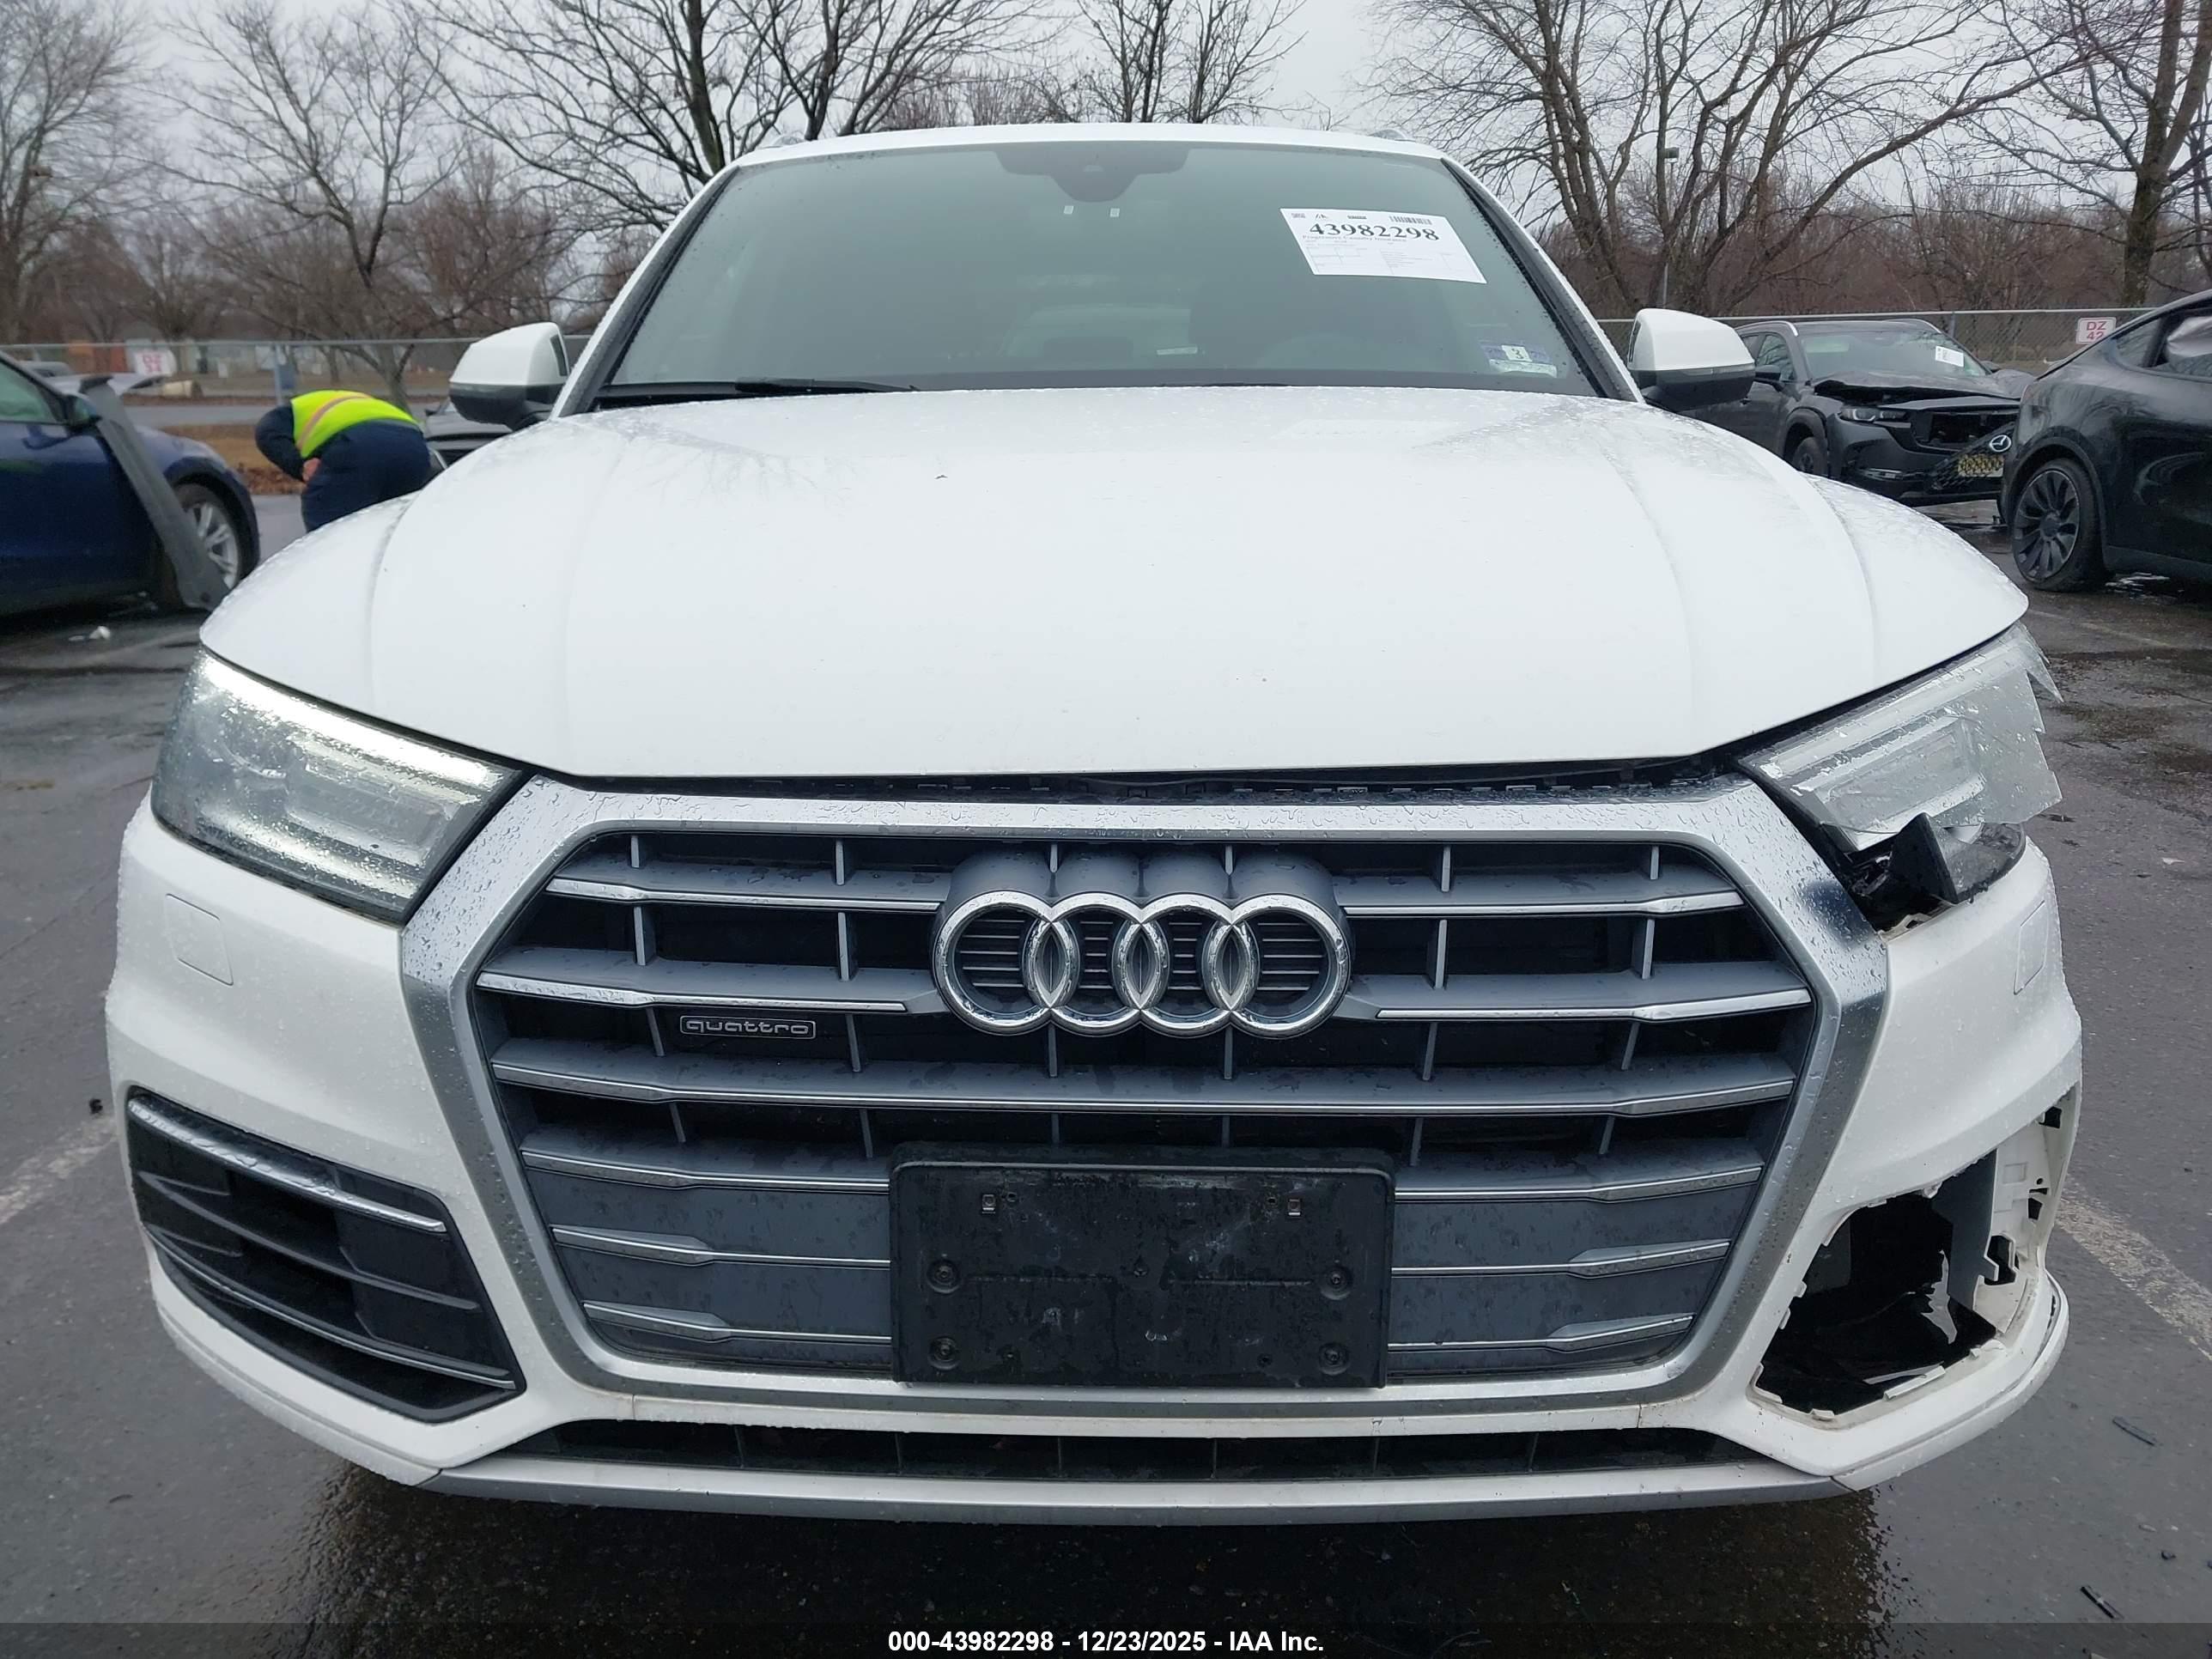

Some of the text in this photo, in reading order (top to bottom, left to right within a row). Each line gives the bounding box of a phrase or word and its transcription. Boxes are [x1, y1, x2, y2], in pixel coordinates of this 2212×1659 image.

[1310, 222, 1440, 240] 43982298
[2087, 321, 2107, 331] DZ
[686, 1020, 809, 1034] quattro
